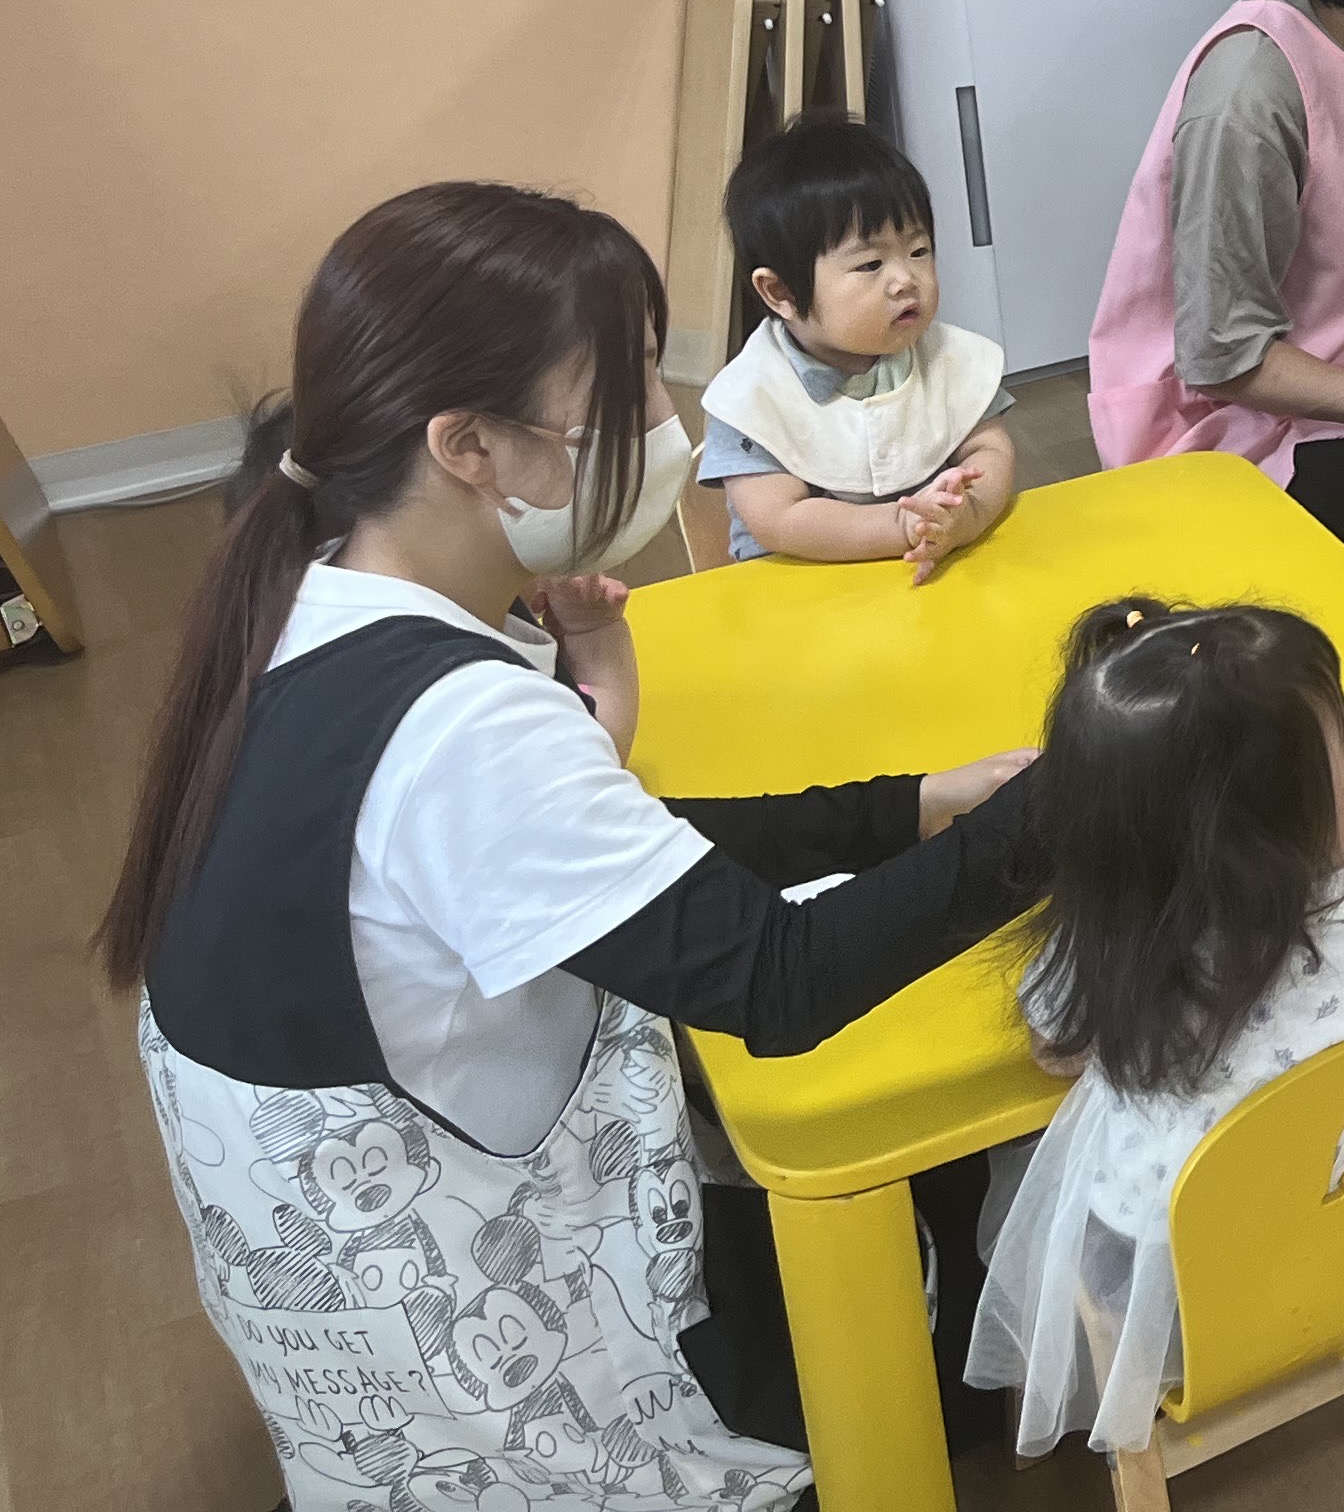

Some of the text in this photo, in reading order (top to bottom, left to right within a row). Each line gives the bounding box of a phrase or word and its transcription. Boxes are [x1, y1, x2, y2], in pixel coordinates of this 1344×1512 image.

[266, 1325, 319, 1357] YOU
[323, 1328, 375, 1356] GET
[284, 1365, 431, 1397] MESSAGE?
